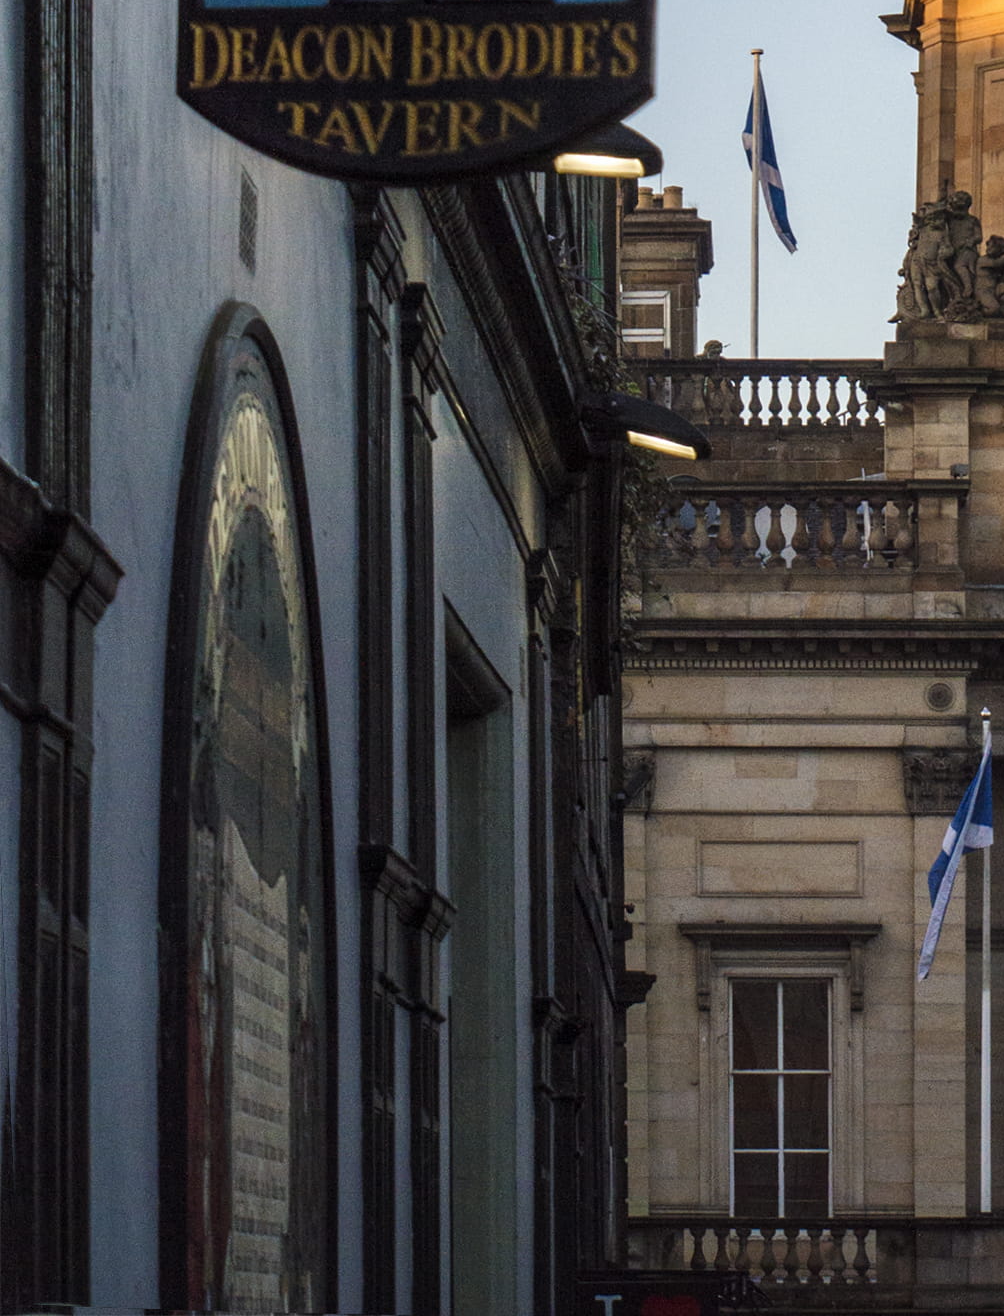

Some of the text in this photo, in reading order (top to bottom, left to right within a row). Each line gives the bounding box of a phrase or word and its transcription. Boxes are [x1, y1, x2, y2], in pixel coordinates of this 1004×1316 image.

[189, 18, 638, 89] DEACON BRODIE'S
[277, 99, 541, 155] TAVERN
